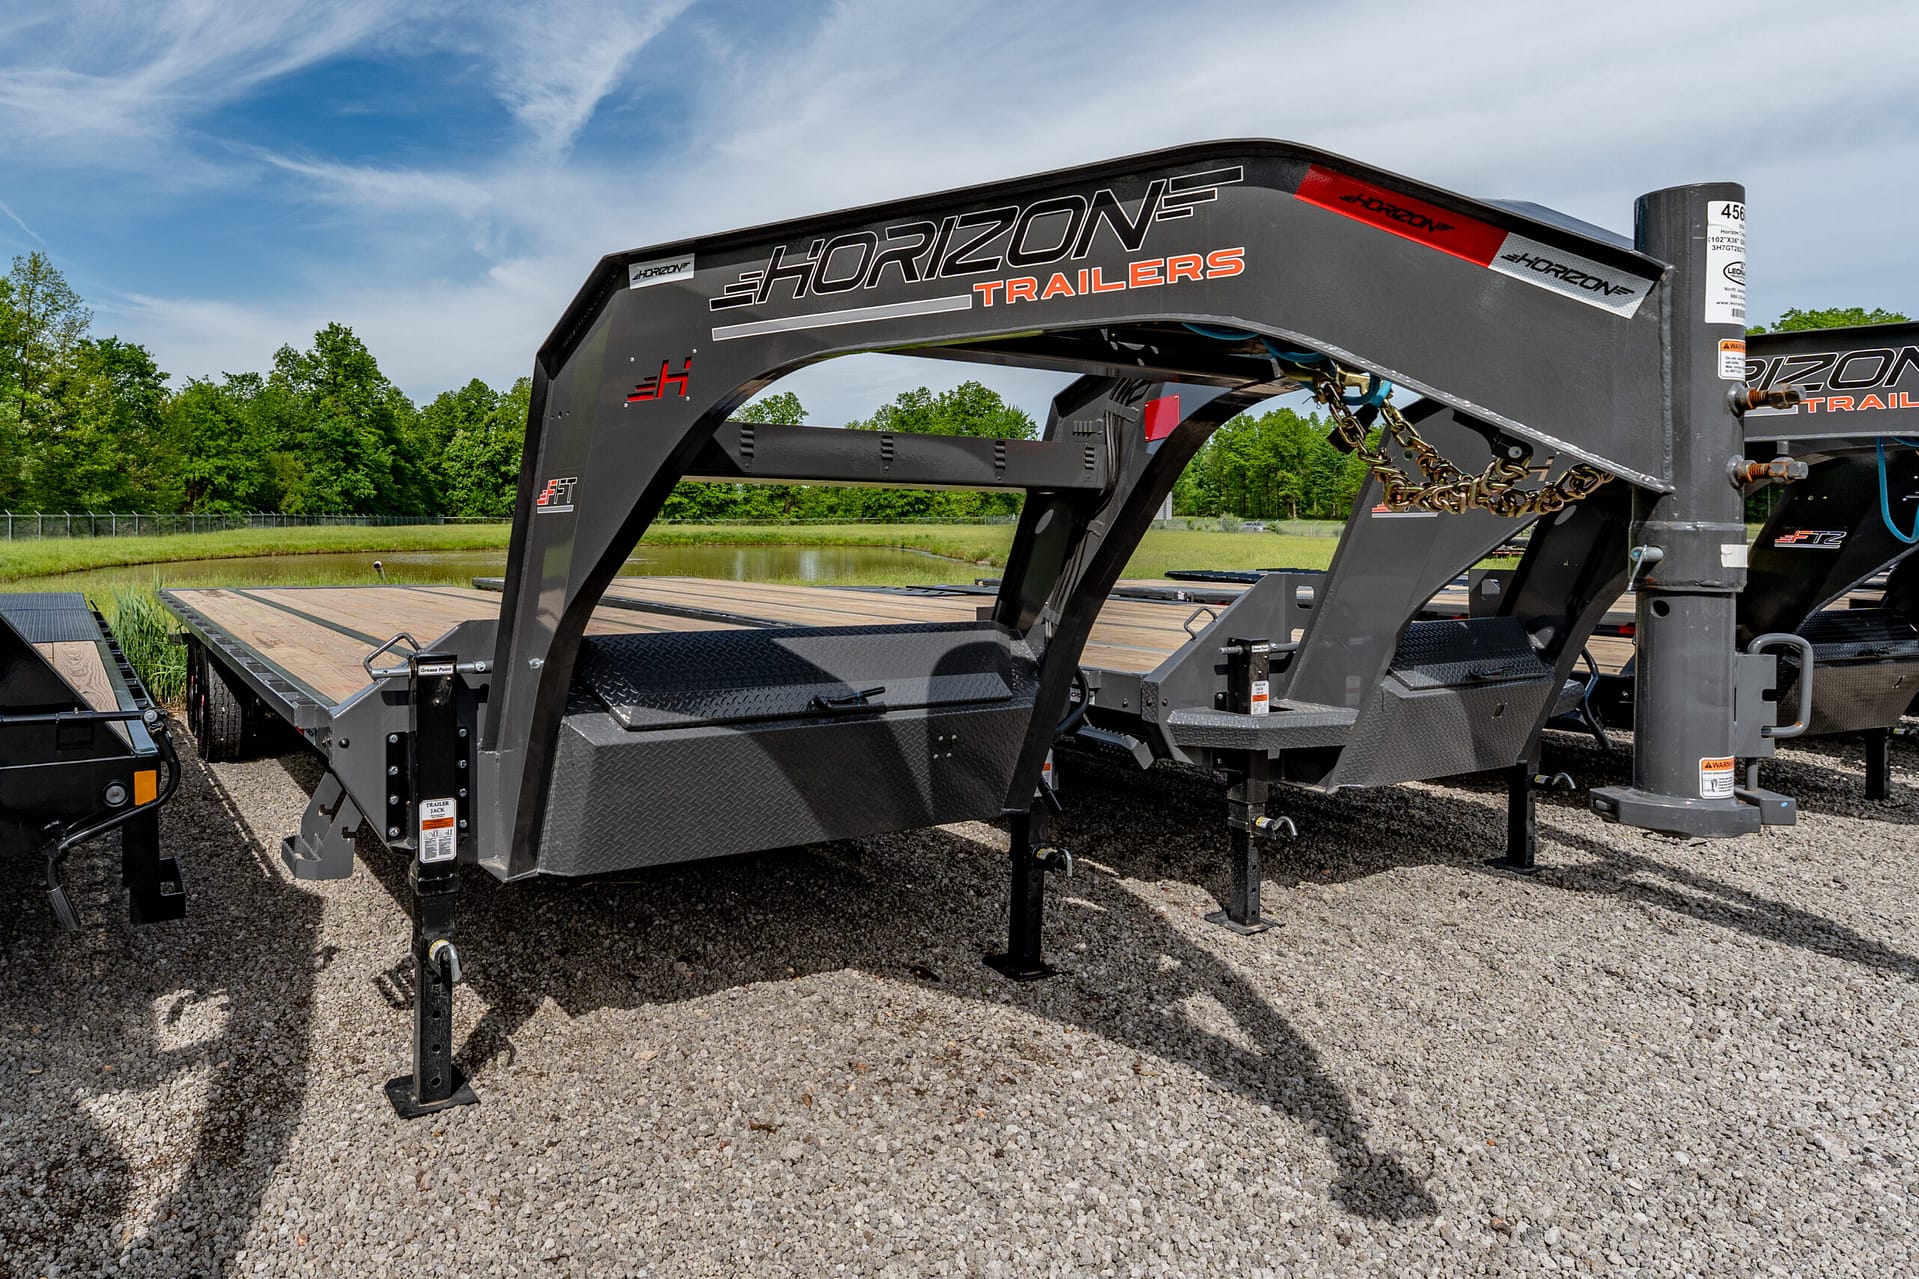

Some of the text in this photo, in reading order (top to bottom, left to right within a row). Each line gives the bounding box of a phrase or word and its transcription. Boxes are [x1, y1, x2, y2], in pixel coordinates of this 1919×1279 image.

[1350, 193, 1441, 232] HORIZON
[755, 177, 1168, 304] HORIZON
[637, 263, 684, 280] HORIZON
[973, 247, 1245, 307] TRAILERS
[1514, 253, 1620, 296] HORIZON
